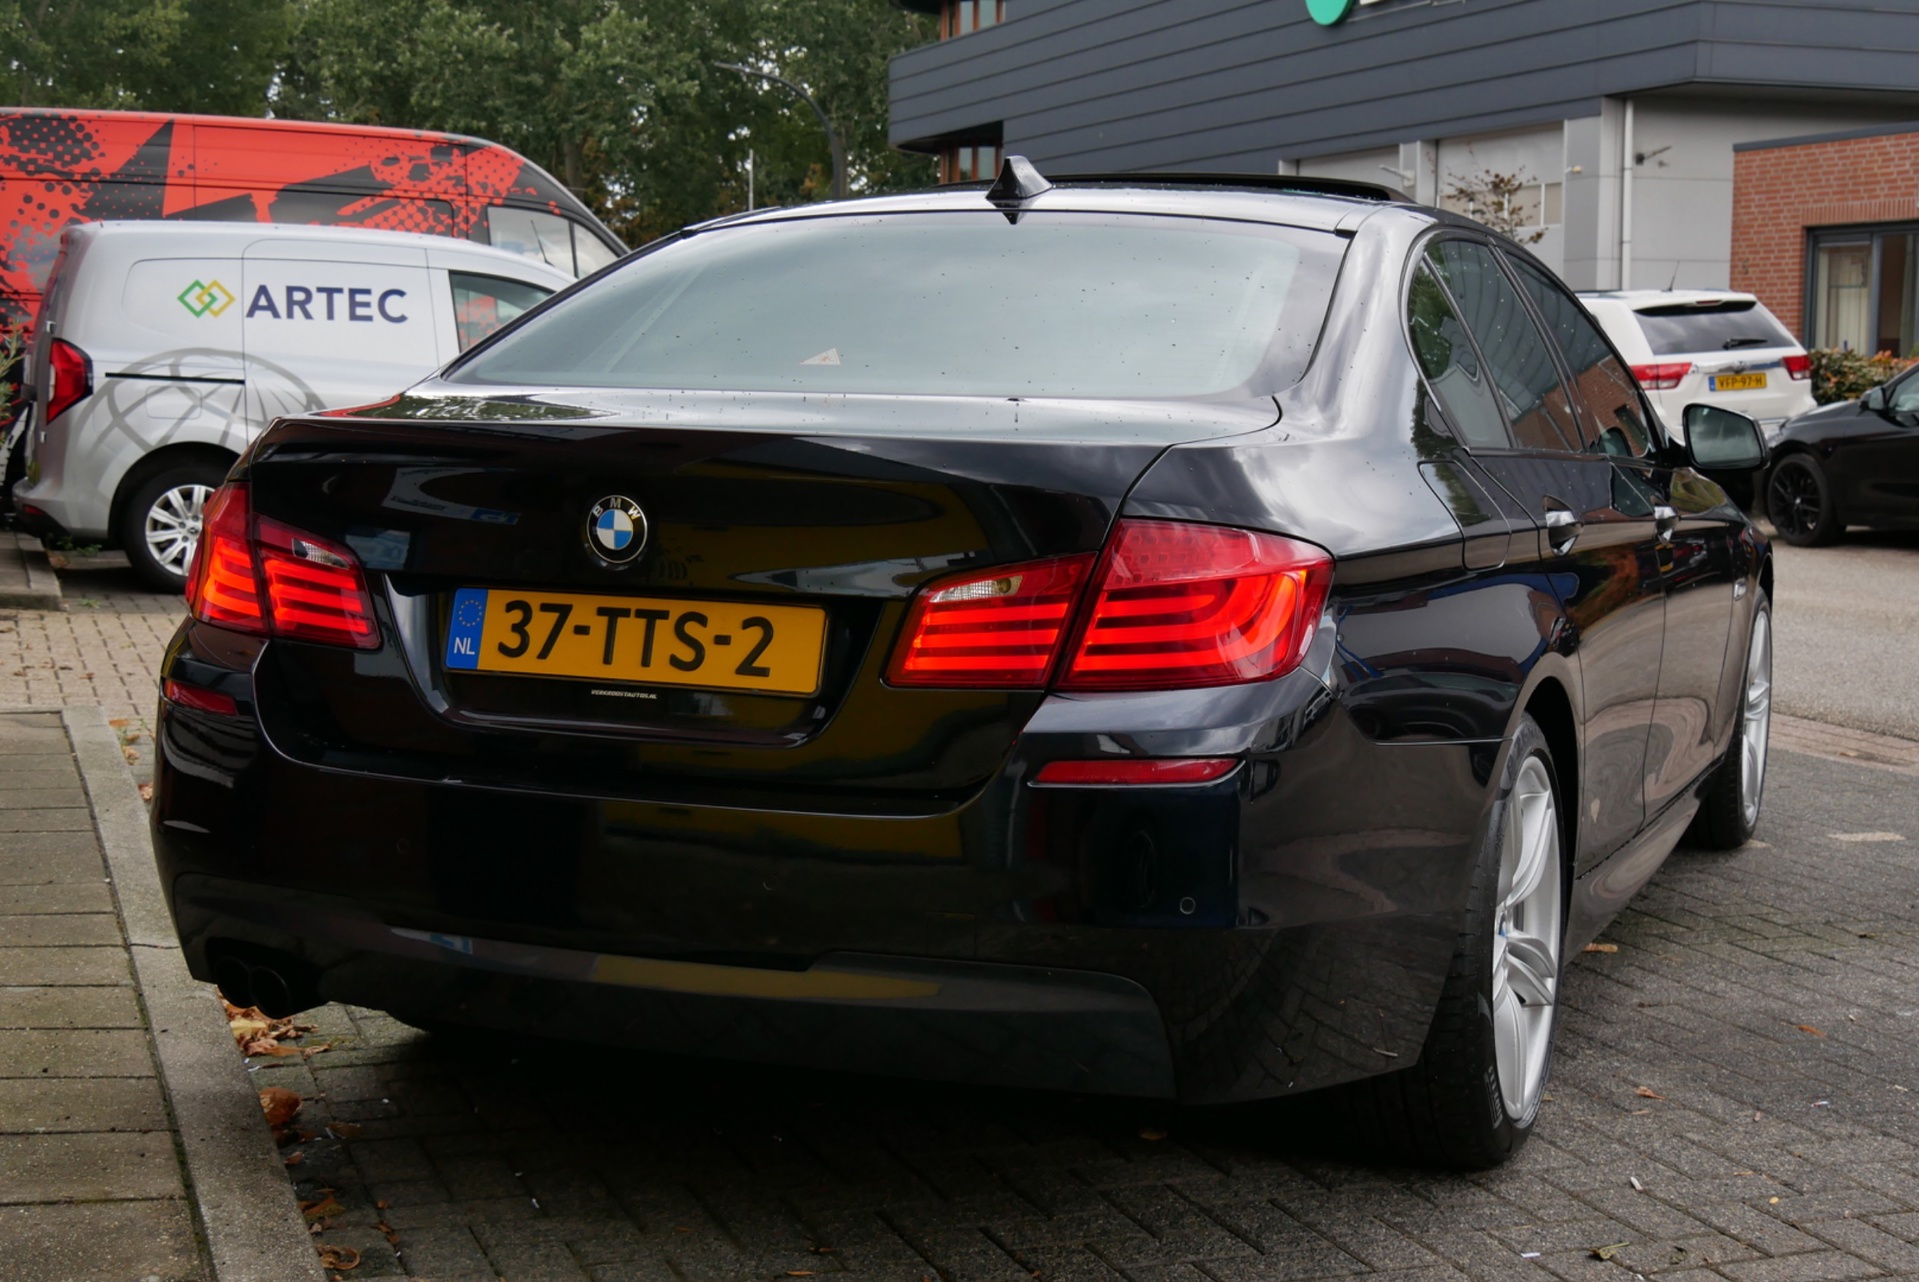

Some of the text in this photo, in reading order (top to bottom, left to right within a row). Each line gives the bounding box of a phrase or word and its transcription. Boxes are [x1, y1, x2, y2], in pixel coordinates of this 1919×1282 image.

[245, 284, 408, 323] ARTEC
[592, 497, 641, 520] BMW
[454, 637, 475, 655] NL
[498, 600, 774, 677] 37-TTS-2
